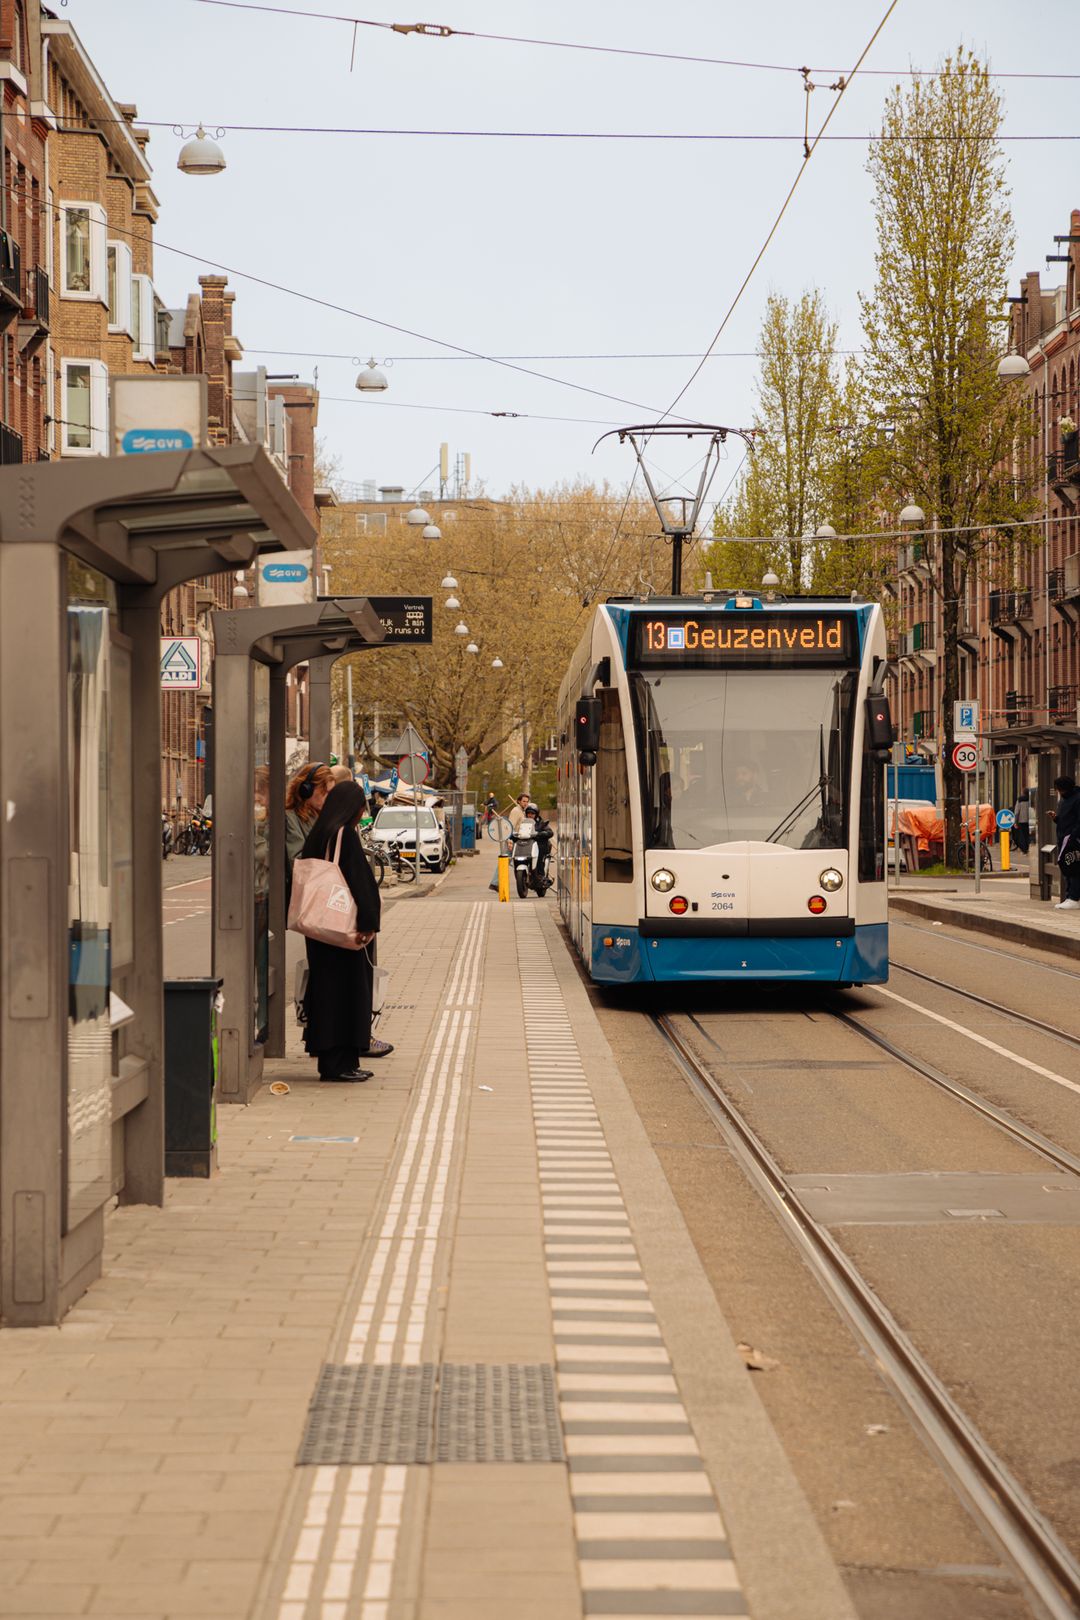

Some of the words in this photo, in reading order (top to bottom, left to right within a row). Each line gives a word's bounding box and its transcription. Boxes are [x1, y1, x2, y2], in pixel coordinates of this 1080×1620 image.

[156, 438, 183, 449] GVB
[284, 569, 302, 577] GVB
[404, 619, 411, 627] 1
[411, 619, 425, 627] min
[395, 627, 412, 635] runs
[646, 621, 665, 649] 13
[684, 620, 841, 649] Geuzenveld
[161, 671, 192, 681] ALDI
[958, 751, 976, 762] 30
[711, 902, 733, 911] 2064
